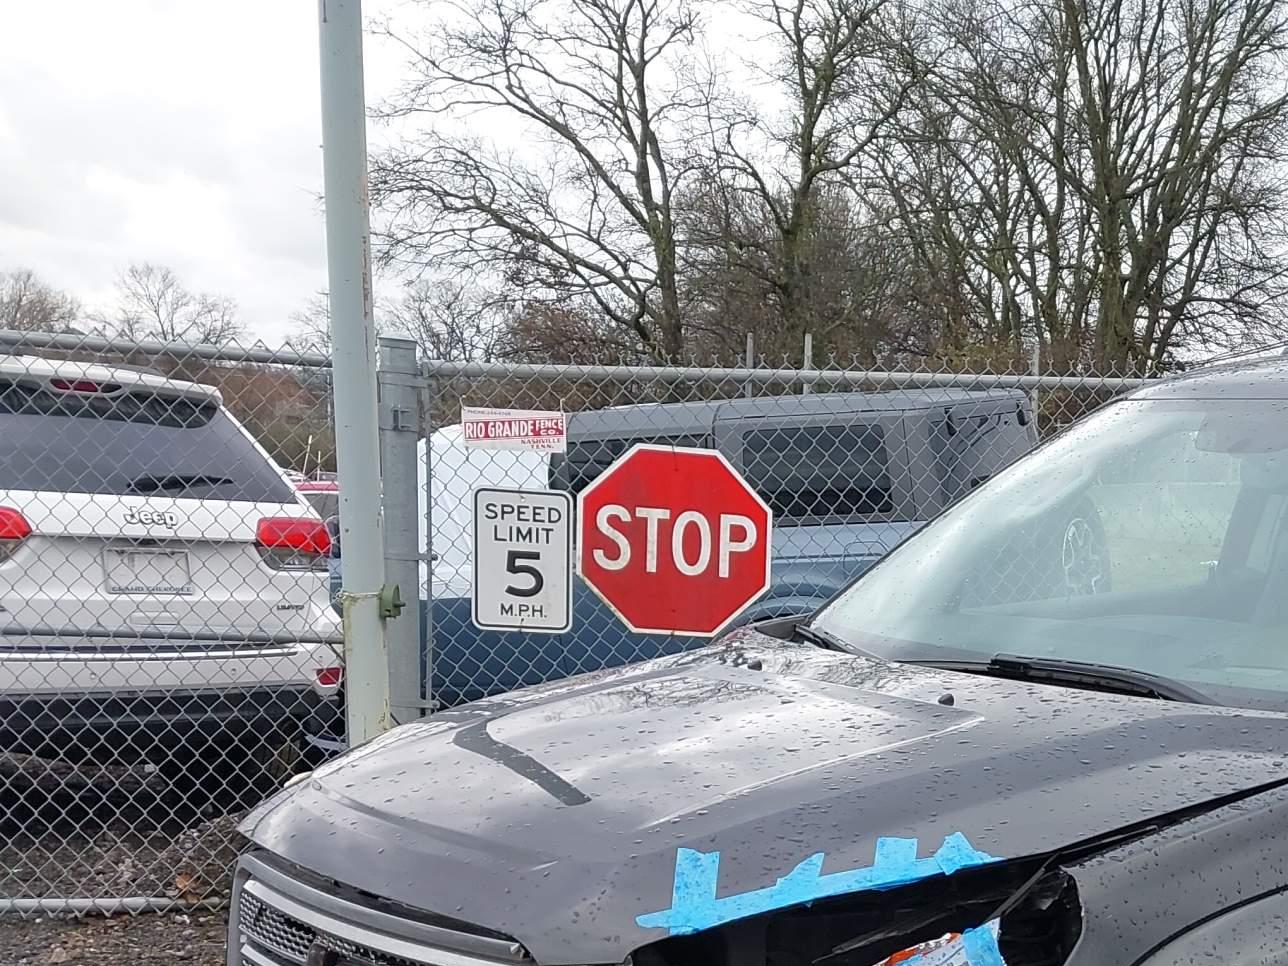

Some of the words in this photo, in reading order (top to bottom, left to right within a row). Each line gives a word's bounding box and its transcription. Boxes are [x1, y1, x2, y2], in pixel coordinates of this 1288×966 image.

[465, 422, 486, 438] RIO
[487, 420, 534, 438] GRANDE
[535, 418, 563, 432] FENCE
[123, 506, 179, 529] Jeep
[484, 503, 562, 524] SPEED
[493, 524, 554, 545] LIMIT
[592, 504, 758, 578] STOP
[504, 550, 544, 598] 5
[500, 603, 548, 618] M.P.H.
